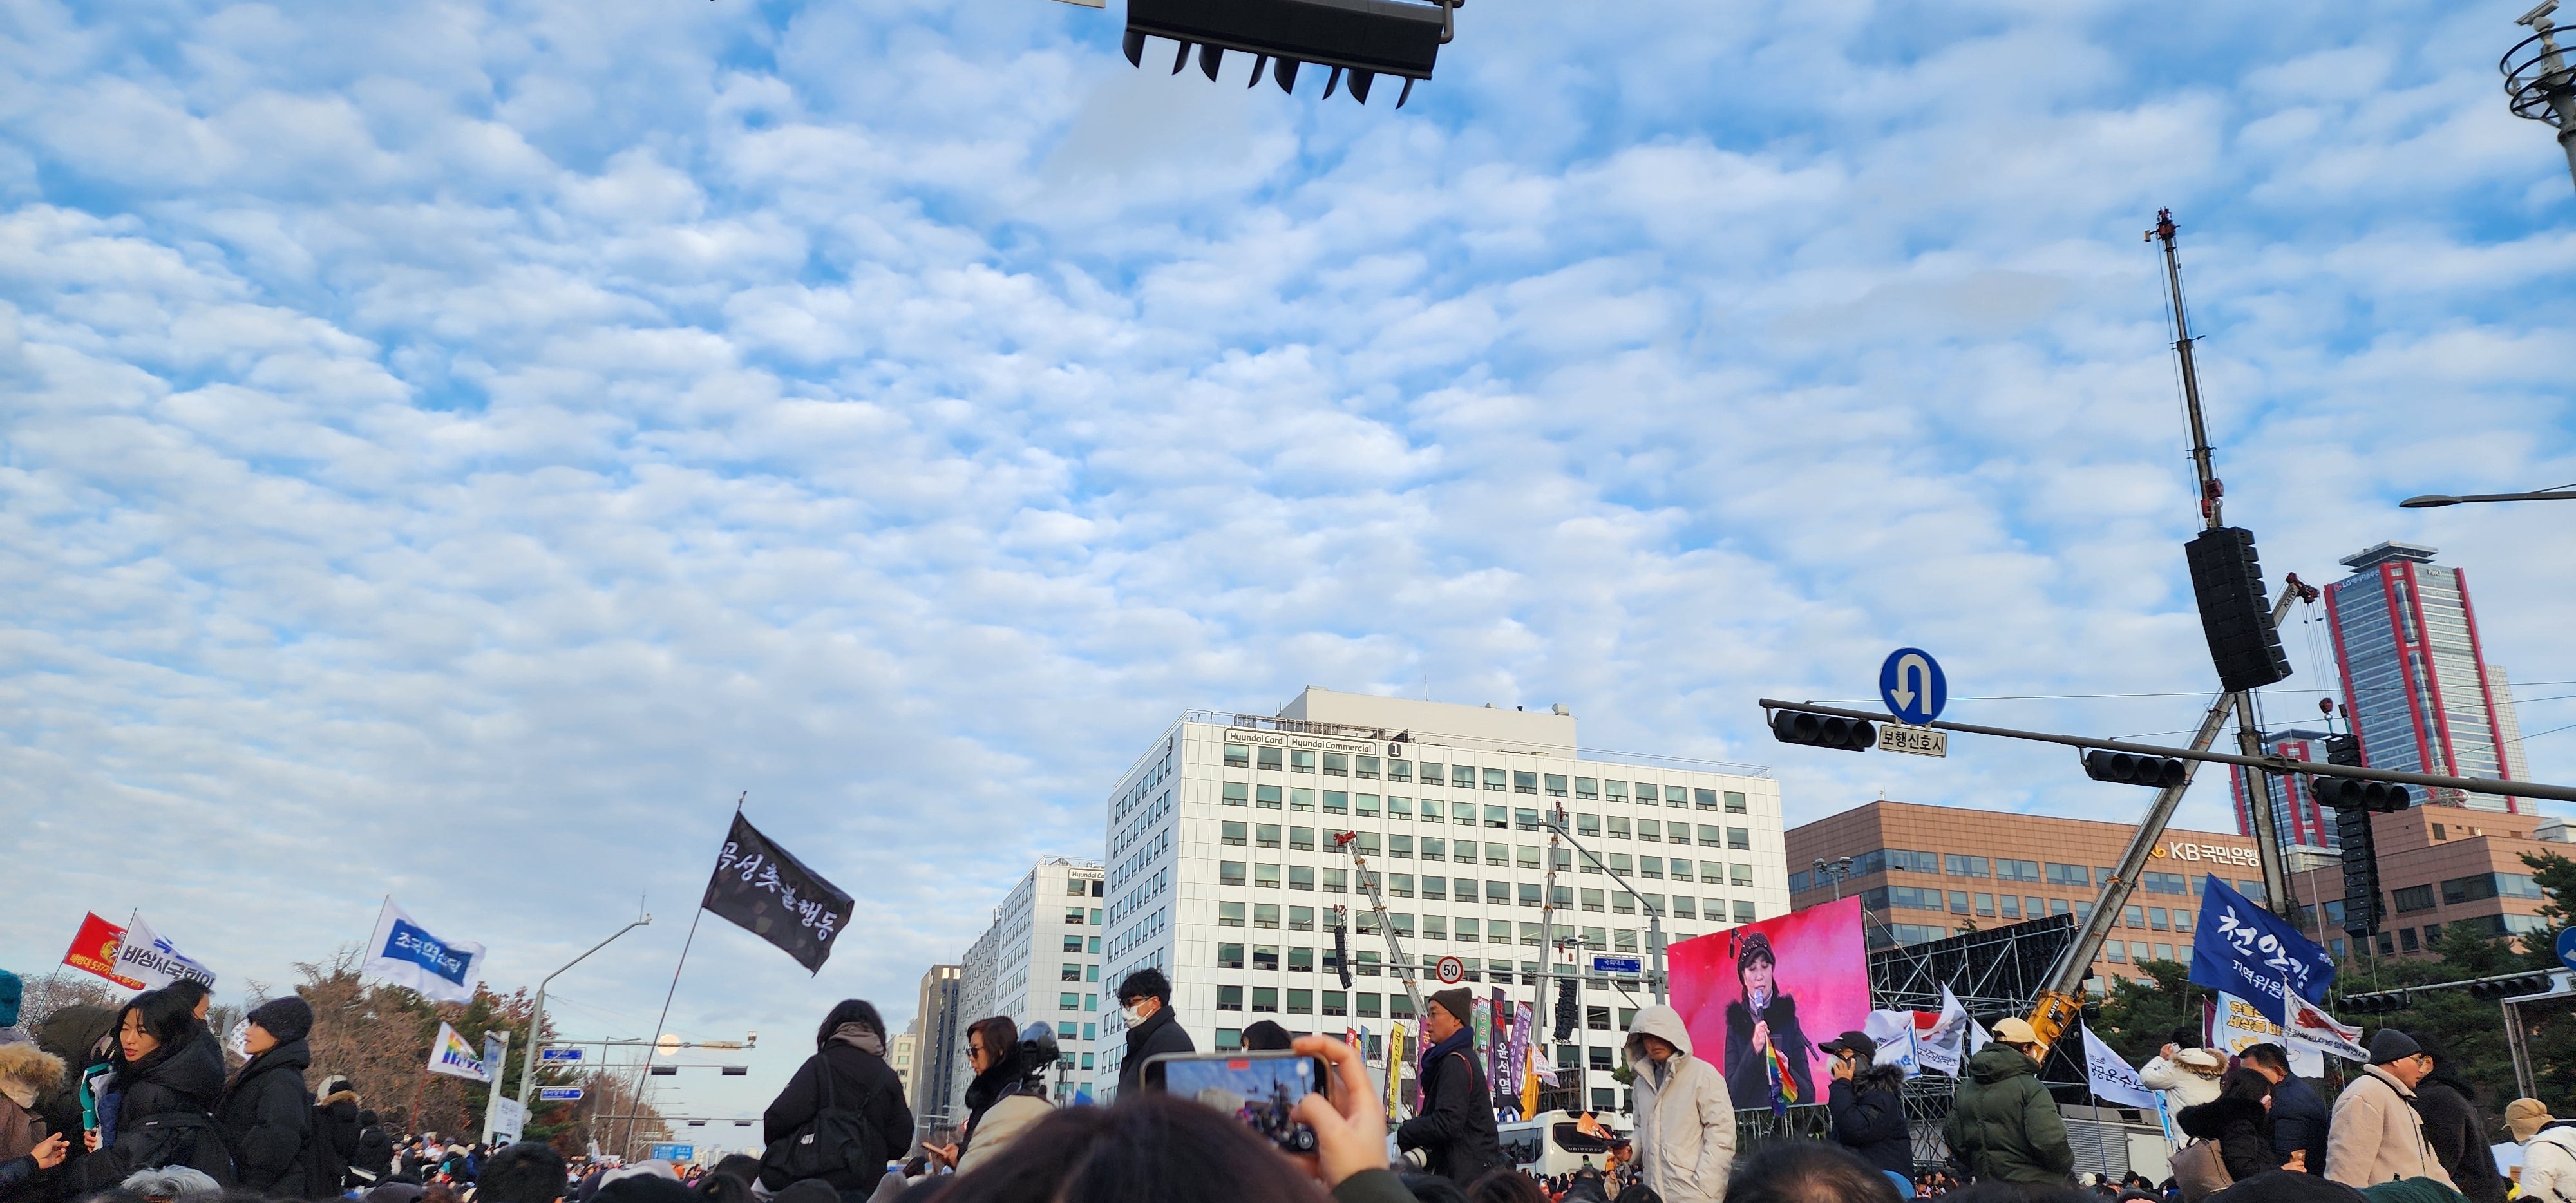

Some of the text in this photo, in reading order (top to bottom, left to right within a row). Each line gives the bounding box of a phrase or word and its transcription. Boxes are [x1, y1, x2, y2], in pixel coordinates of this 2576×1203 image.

[2283, 590, 2297, 608] KATO
[1230, 732, 1283, 744] Hyundai Card
[1292, 738, 1371, 753] Hyundai Commercial
[1882, 730, 1944, 753] 보행신호시
[2170, 841, 2259, 867] KB국민은행
[719, 841, 837, 942] 곡성촛불행동
[70, 953, 91, 968] 해병대
[395, 932, 462, 974] 조국혁신당
[1443, 964, 1457, 976] 50
[2047, 999, 2060, 1019] KATO
[2227, 1014, 2266, 1033] 세상을
[1496, 1042, 1512, 1095] 윤석열
